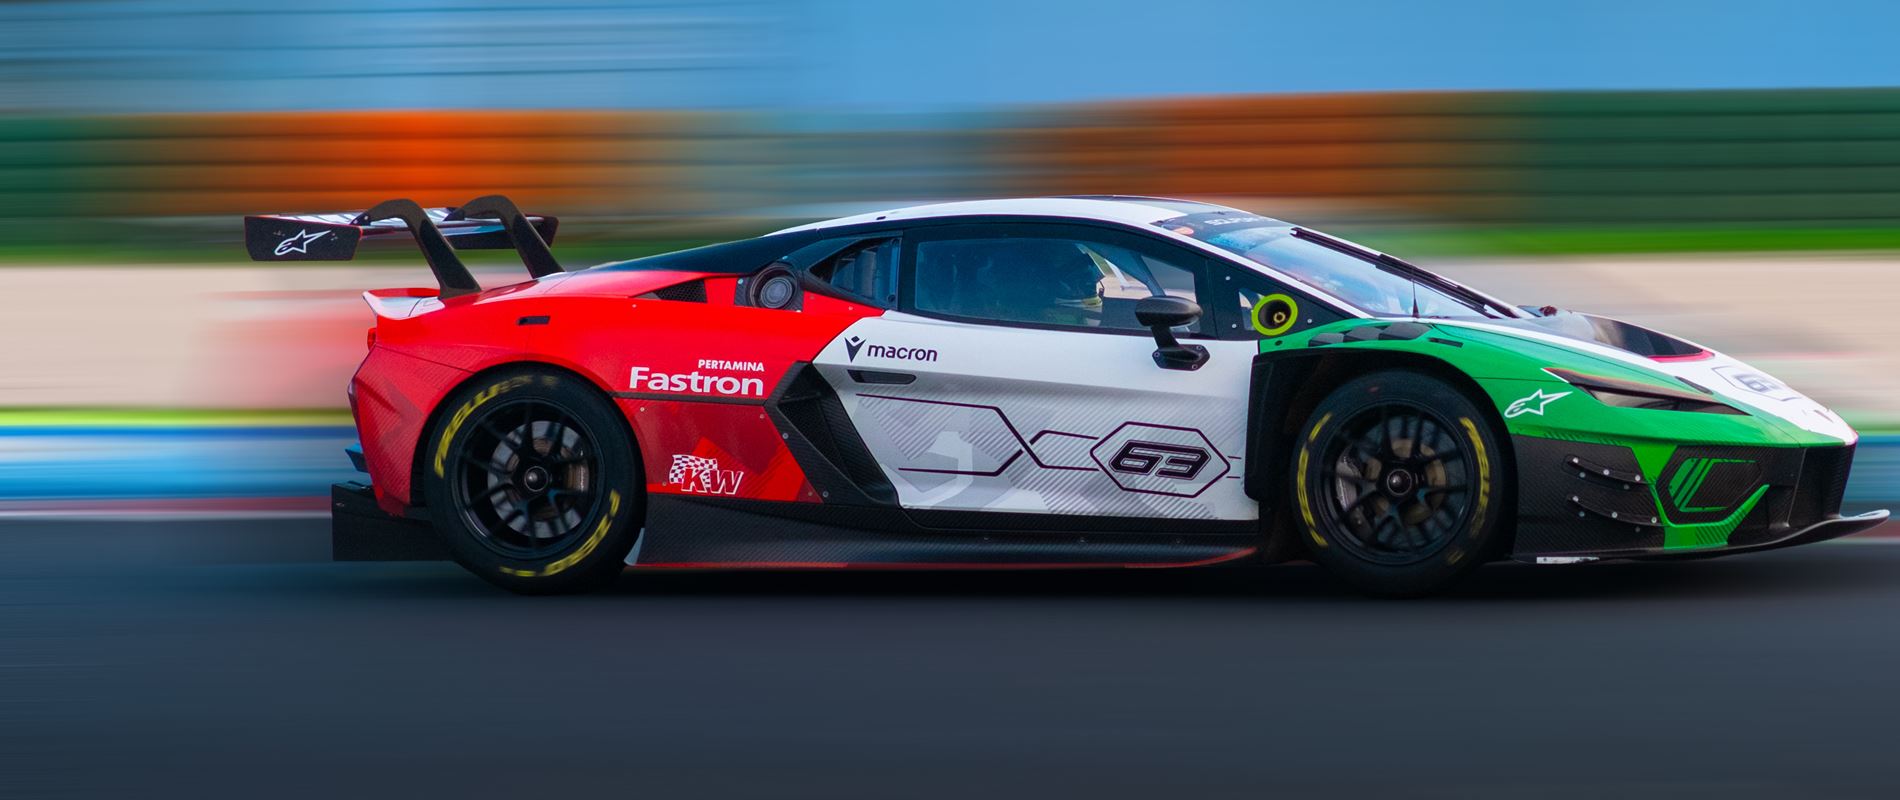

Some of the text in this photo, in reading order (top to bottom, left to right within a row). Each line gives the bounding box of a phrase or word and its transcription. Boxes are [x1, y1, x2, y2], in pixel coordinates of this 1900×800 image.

[699, 359, 765, 372] PERTAMINA
[868, 345, 938, 362] macron
[629, 366, 763, 396] Fastron
[1110, 440, 1211, 481] 63
[681, 467, 744, 494] KW
